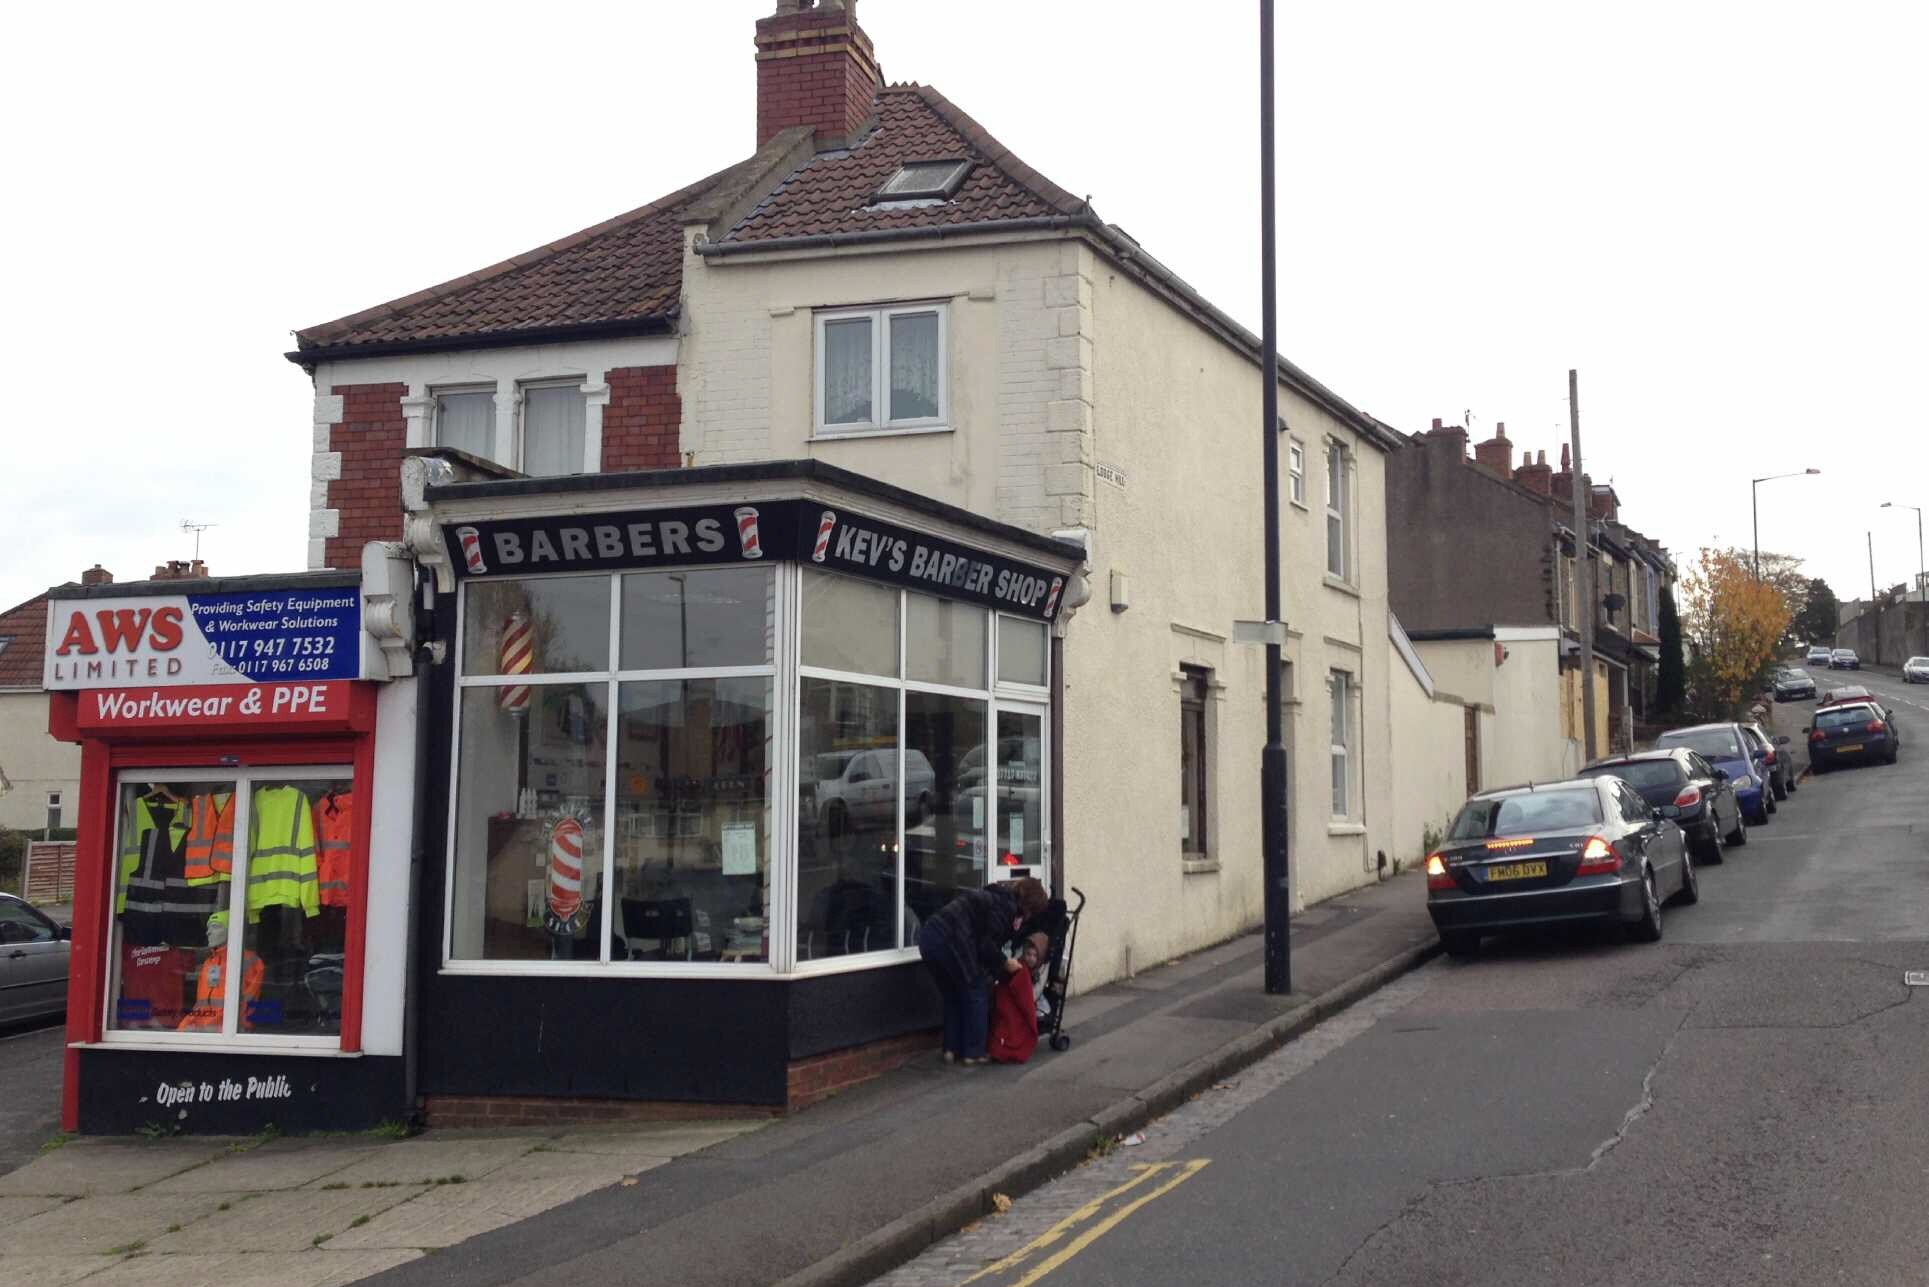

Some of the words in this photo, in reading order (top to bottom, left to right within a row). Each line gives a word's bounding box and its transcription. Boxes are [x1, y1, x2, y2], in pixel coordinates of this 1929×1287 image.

[493, 518, 725, 565] BARBERS
[834, 524, 907, 572] KEV'S
[909, 546, 993, 594] BARBER
[994, 569, 1047, 607] SHOP
[192, 603, 243, 615] Providing
[246, 600, 284, 613] Safety
[287, 597, 354, 612] Equipment
[56, 606, 183, 656] AWS
[205, 620, 215, 633] &
[219, 620, 278, 632] Workwear
[281, 616, 338, 629] Solutions
[208, 640, 248, 660] 0117
[254, 638, 286, 657] 947
[292, 636, 335, 655] 7532
[55, 657, 182, 680] LIMITED
[238, 660, 268, 673] 0117
[272, 659, 294, 672] 967
[298, 658, 329, 671] 6508
[97, 692, 232, 719] Workwear
[239, 686, 262, 714] &
[271, 685, 327, 713] PPE
[157, 1082, 195, 1108] Open
[199, 1082, 213, 1102] to
[218, 1078, 242, 1101] the
[246, 1075, 291, 1099] Public
